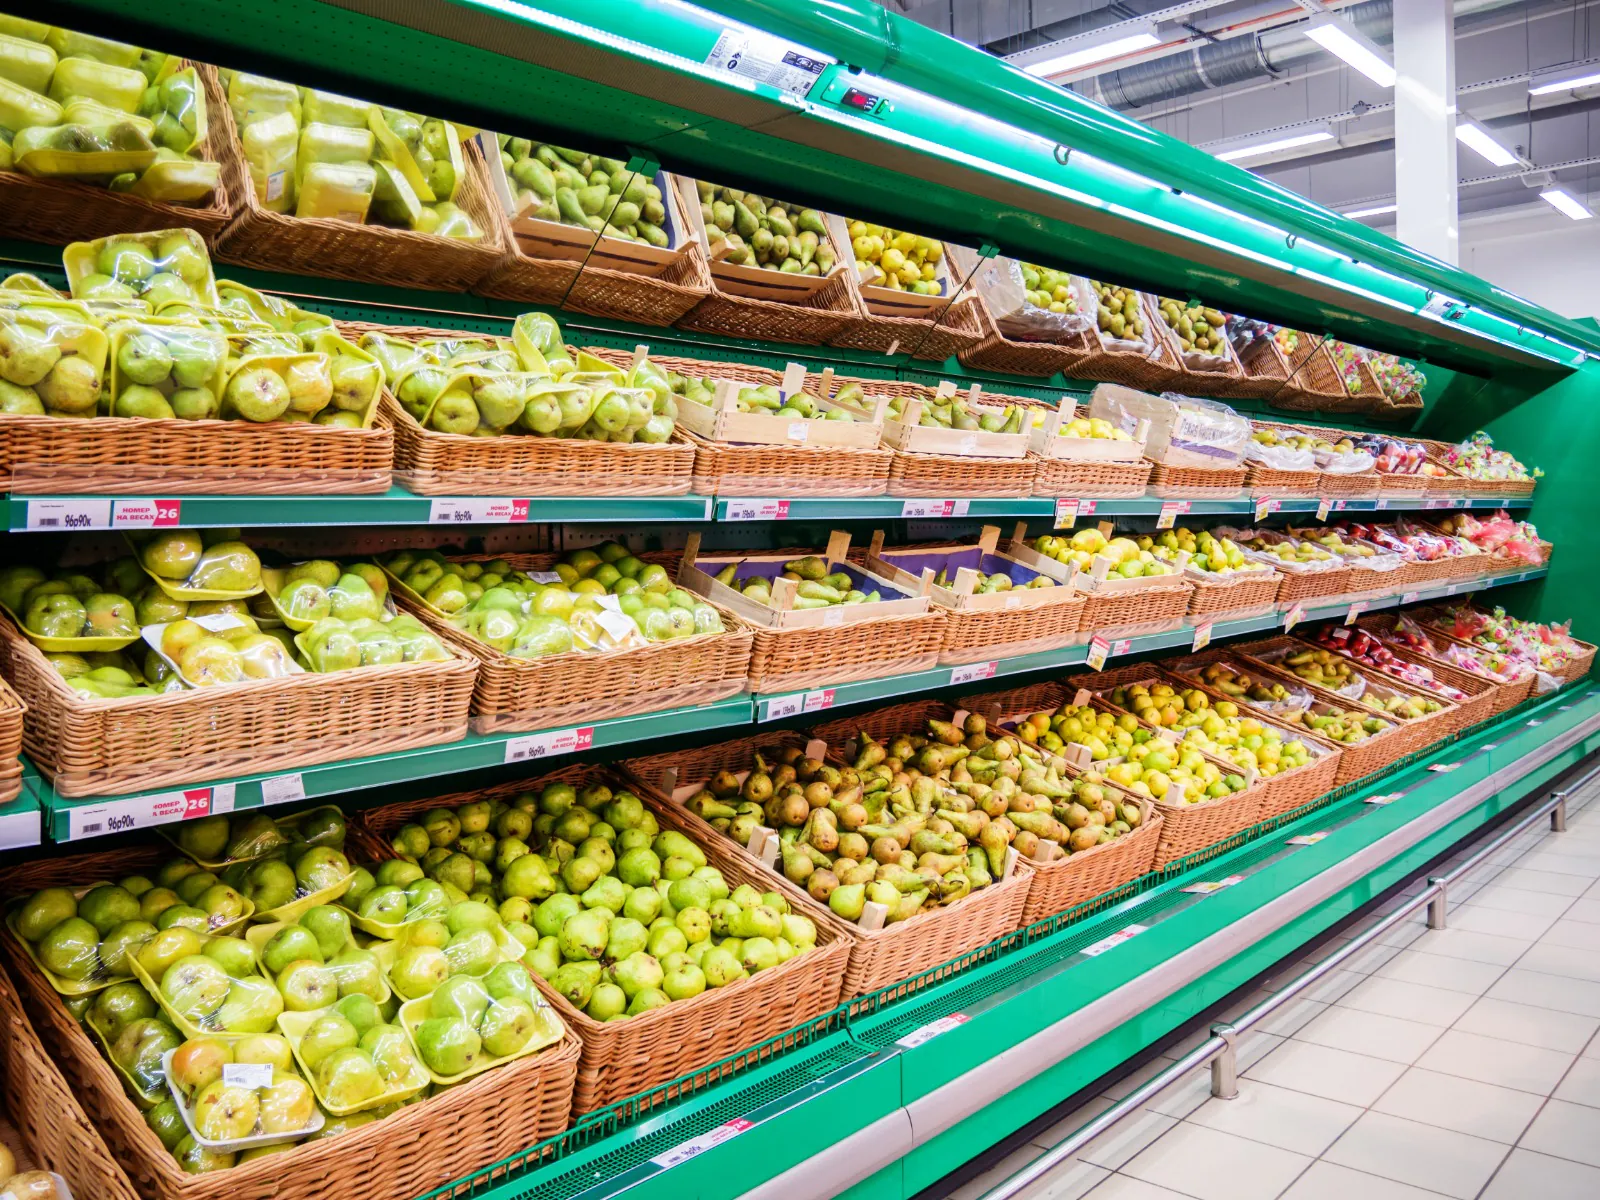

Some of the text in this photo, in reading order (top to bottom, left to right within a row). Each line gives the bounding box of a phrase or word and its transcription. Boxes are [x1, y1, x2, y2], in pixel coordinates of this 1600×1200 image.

[158, 508, 178, 518] 26
[513, 507, 527, 515] 26
[778, 506, 788, 514] 22
[578, 734, 591, 744] 26
[188, 797, 208, 810] 26
[159, 807, 184, 816] ВЕСАХ
[108, 815, 135, 831] 96р90к
[733, 1119, 748, 1129] 26
